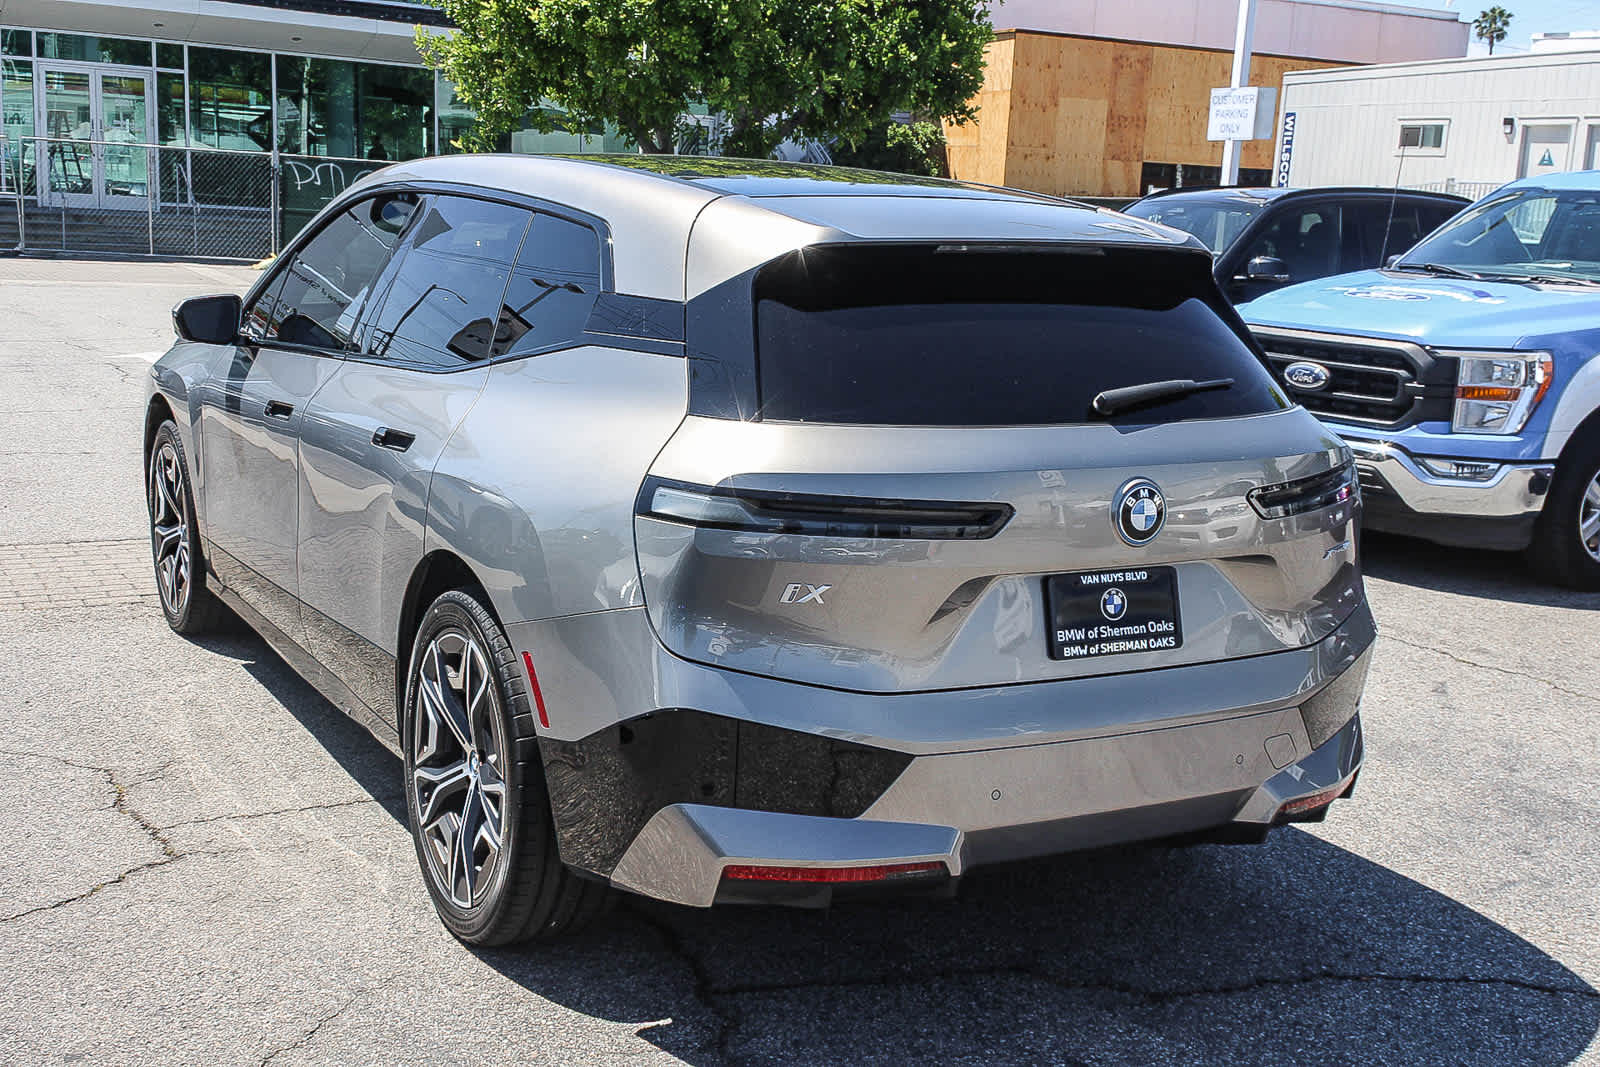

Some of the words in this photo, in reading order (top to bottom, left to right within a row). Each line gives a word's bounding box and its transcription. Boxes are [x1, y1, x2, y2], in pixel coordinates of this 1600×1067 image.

[1212, 95, 1256, 105] CUSTOMER
[1215, 109, 1249, 118] PARKING
[1220, 123, 1240, 133] ONLY
[1280, 115, 1296, 187] WILLSCO
[1125, 488, 1163, 511] BMW
[1080, 574, 1100, 585] VAN
[1100, 572, 1124, 584] NUYS
[1125, 571, 1148, 581] BLVD
[1056, 628, 1085, 642] BMW
[1087, 626, 1099, 639] of
[1100, 624, 1147, 638] Sherman
[1147, 620, 1175, 633] Oaks
[1063, 645, 1088, 657] BMW
[1089, 643, 1100, 655] of
[1100, 639, 1148, 654] SHERMAN
[1148, 636, 1176, 649] OAKS
